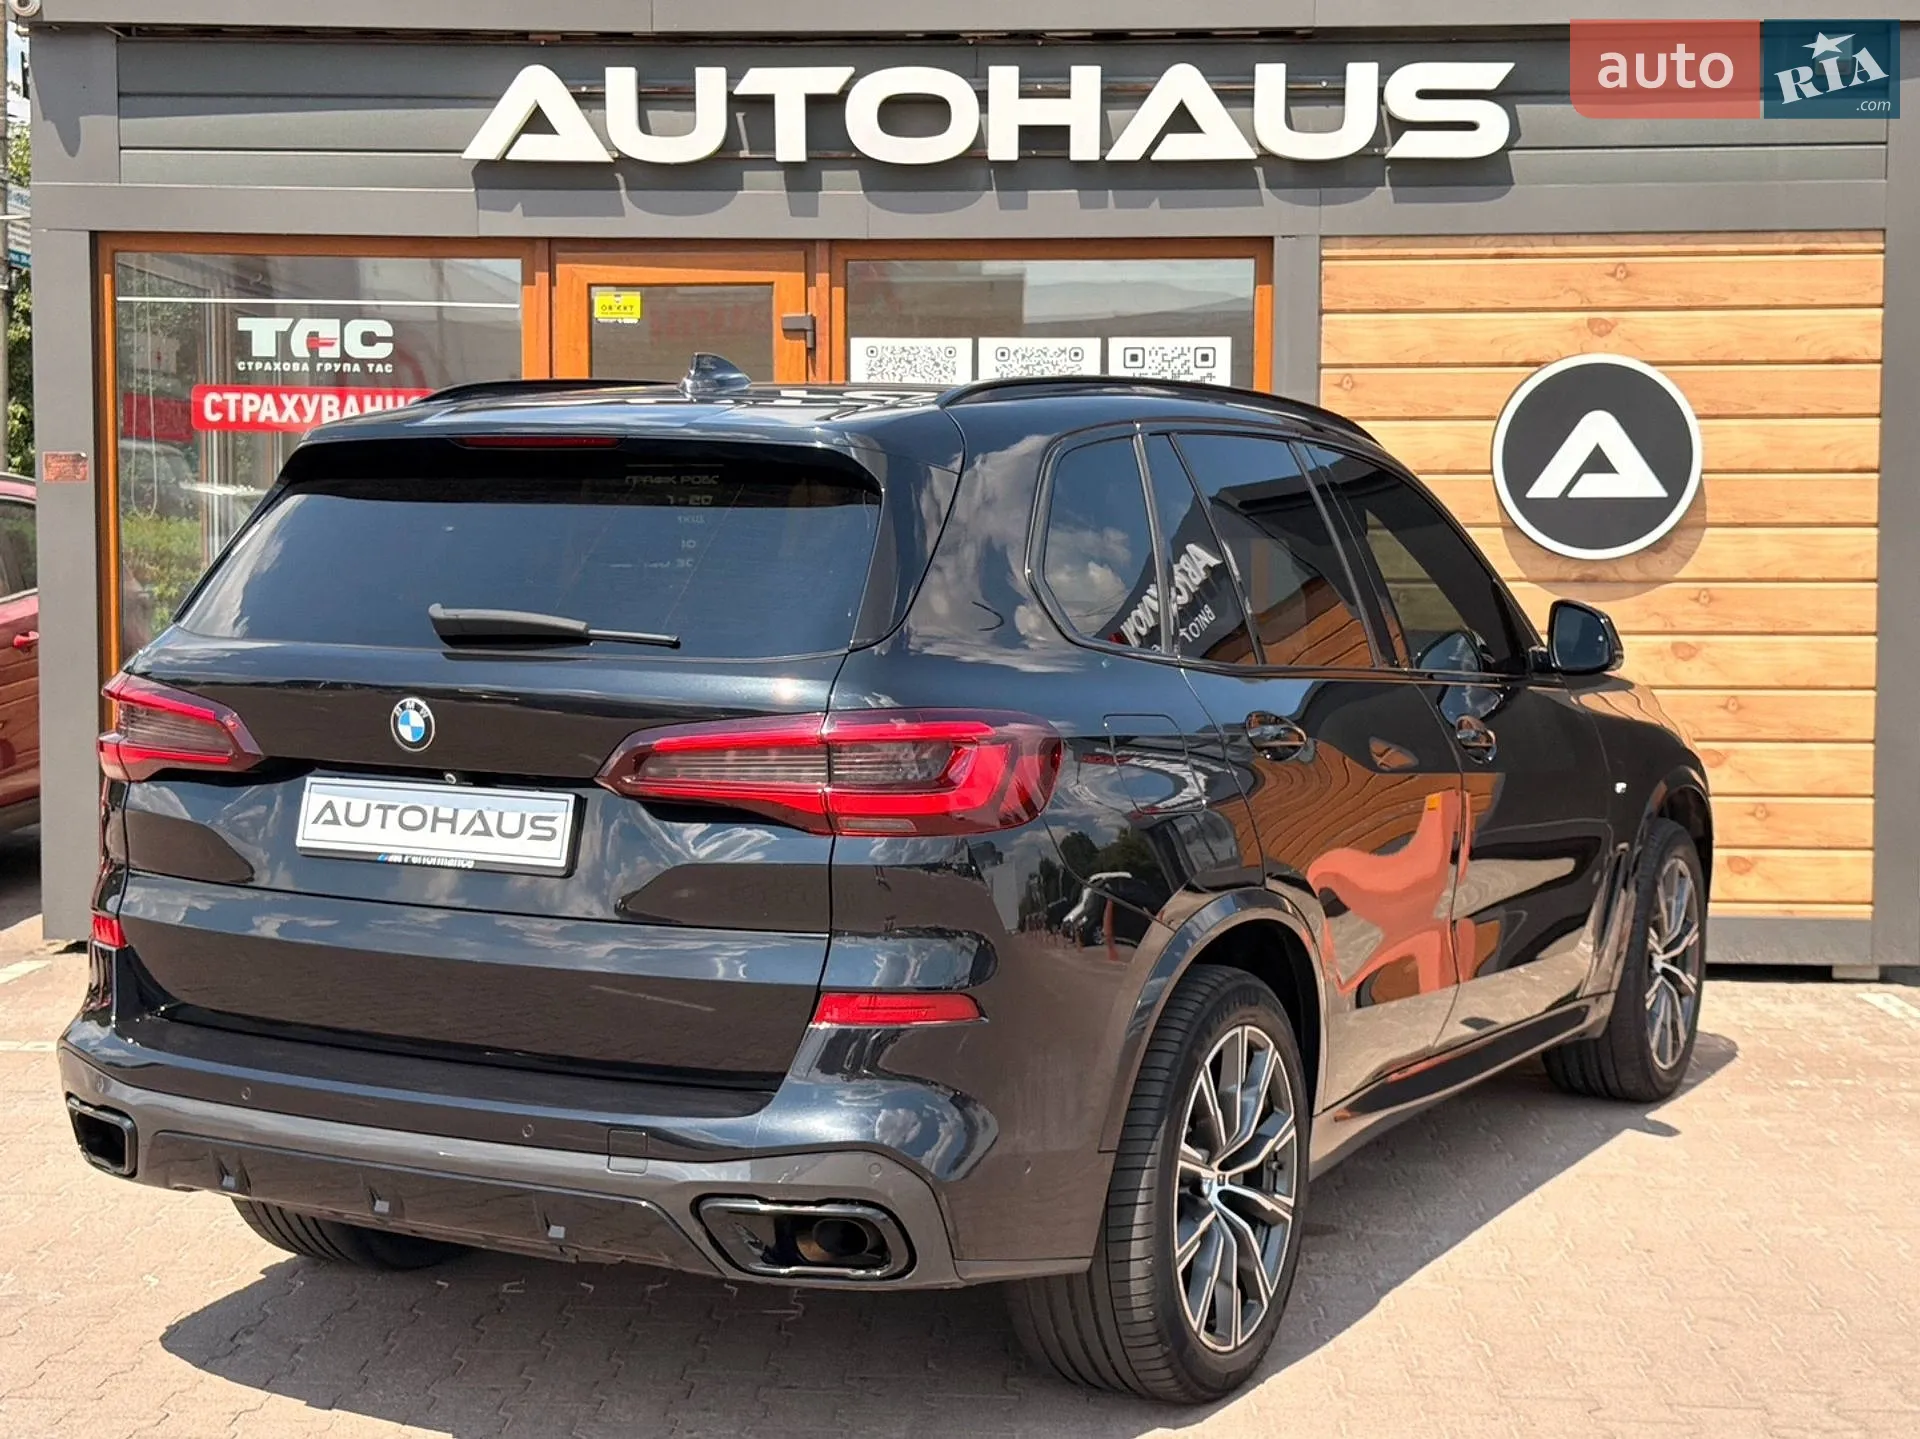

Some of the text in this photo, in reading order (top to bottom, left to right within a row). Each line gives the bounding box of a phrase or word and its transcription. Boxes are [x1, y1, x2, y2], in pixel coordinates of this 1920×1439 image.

[461, 61, 1516, 165] AUTOHAUS
[237, 361, 393, 373] СТРАХОВА ГРУПА ТАС
[311, 800, 560, 842] AUTOHAUS
